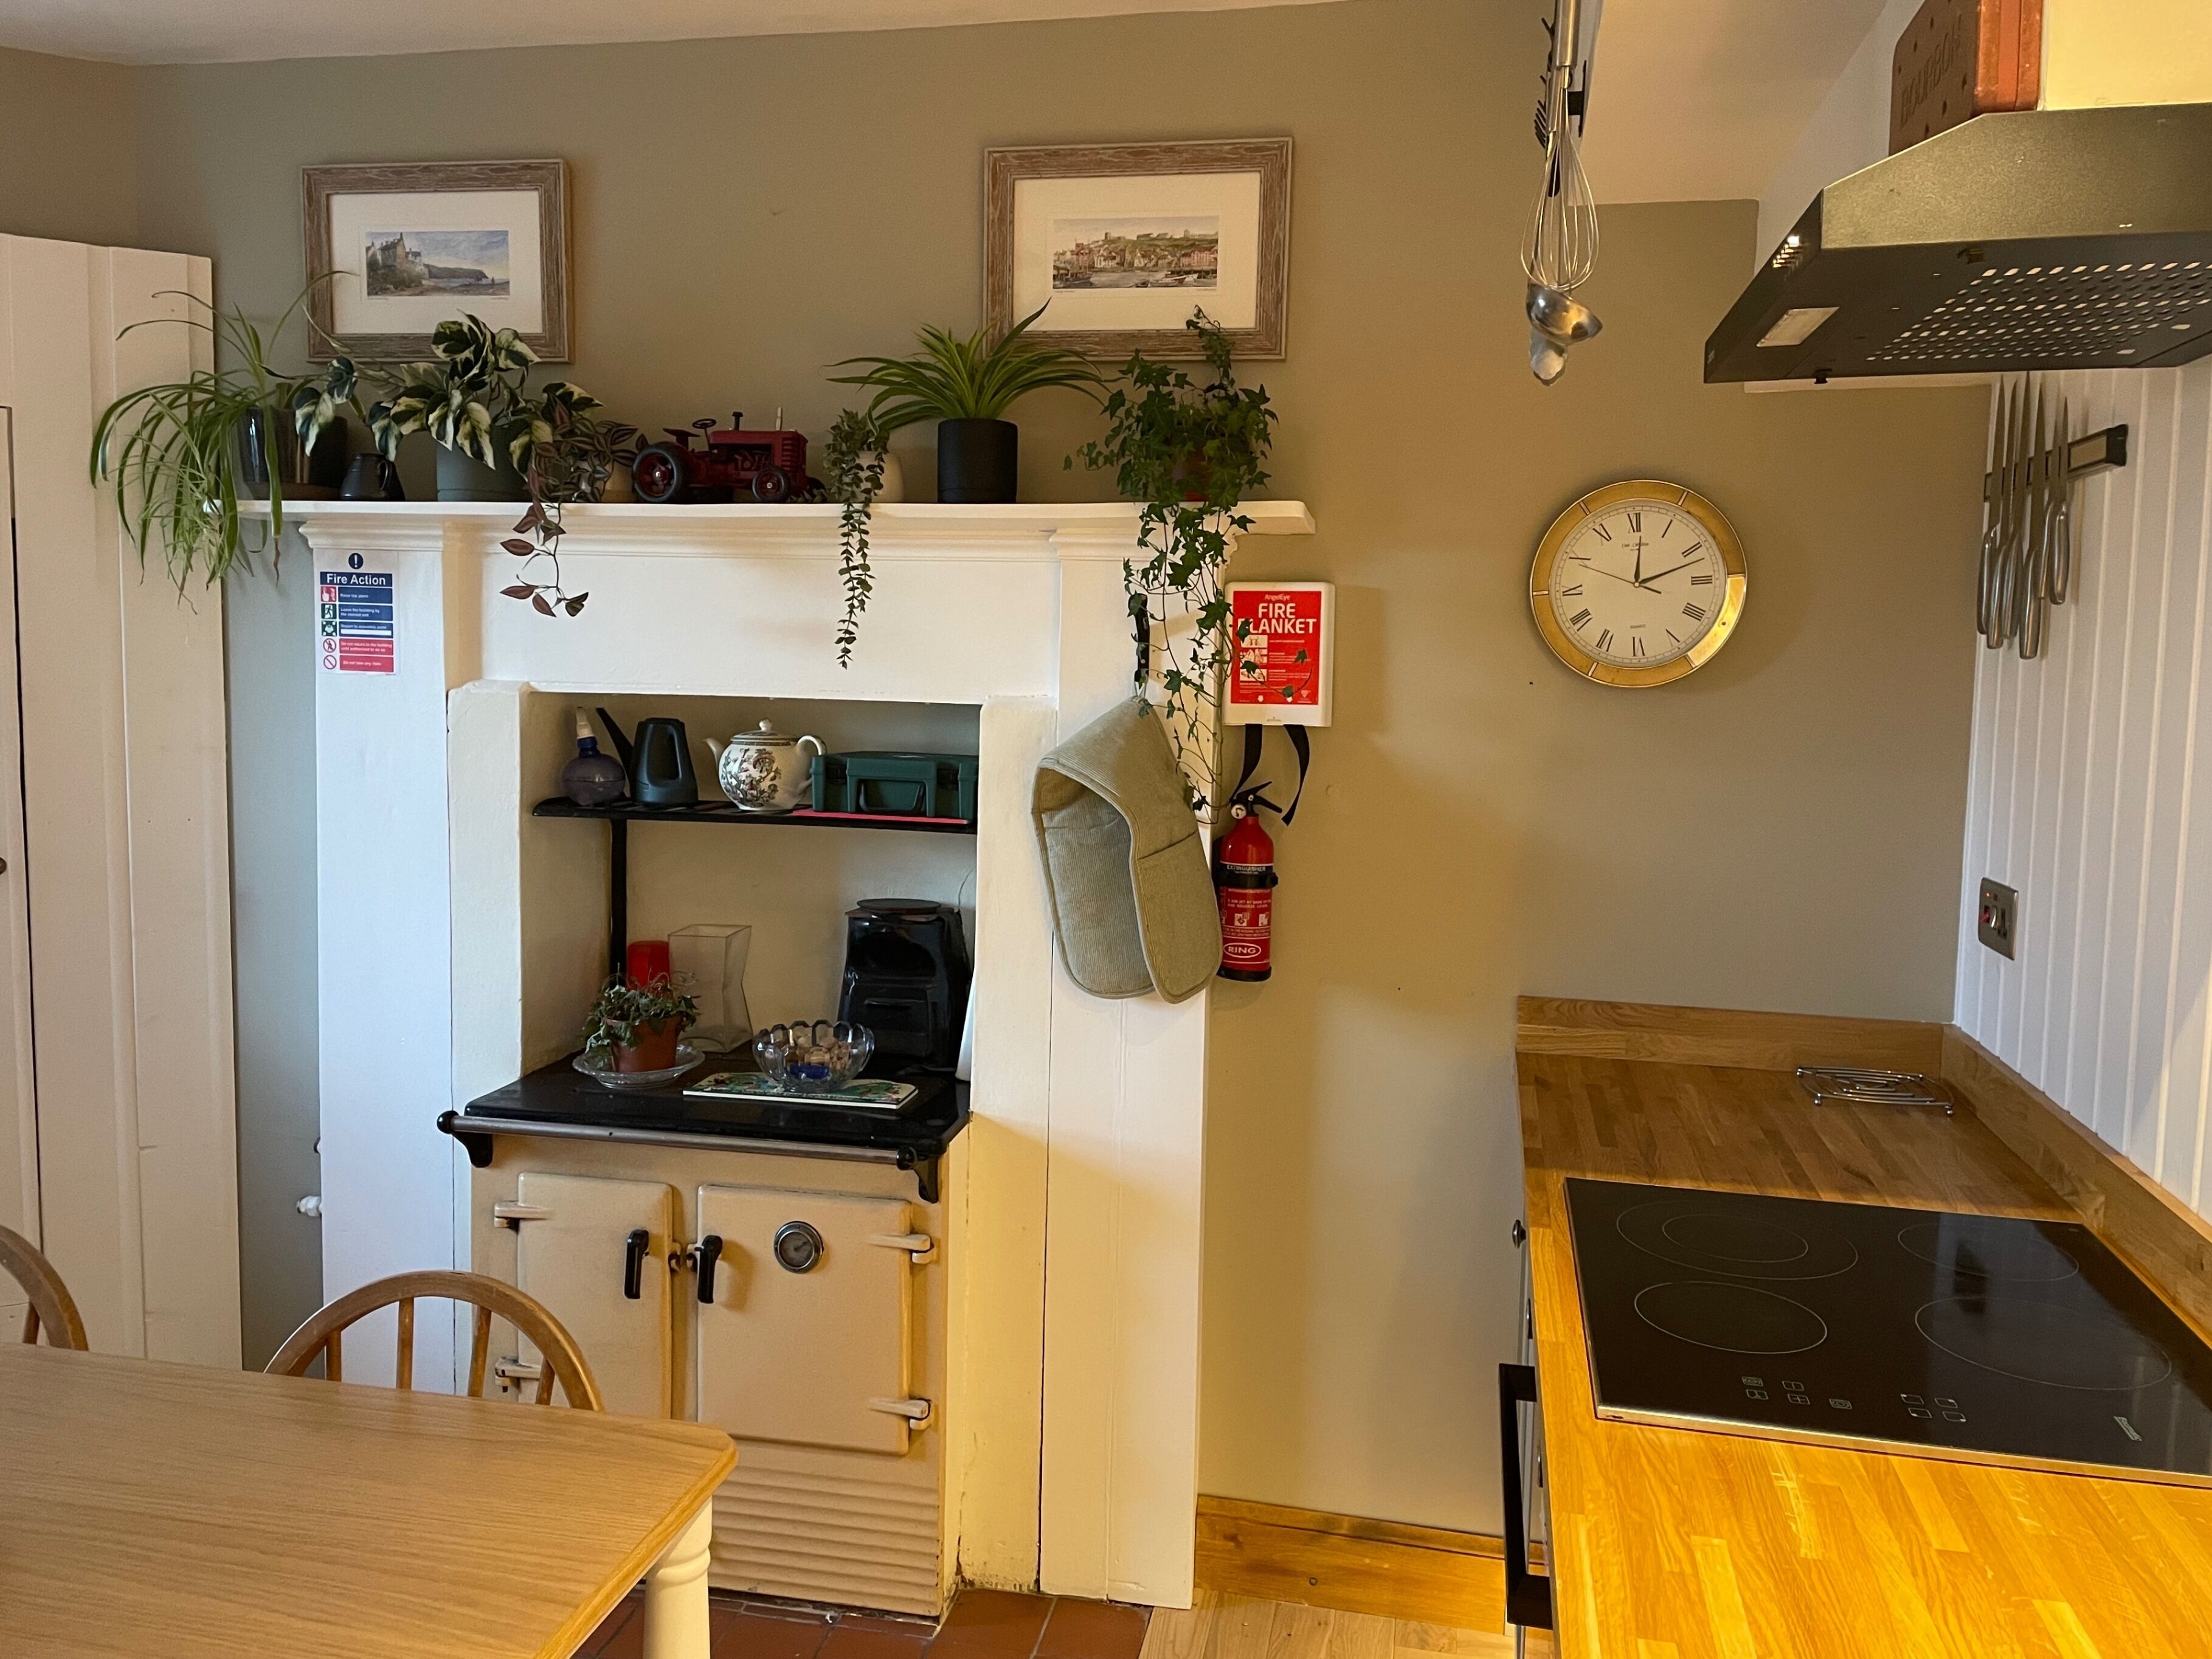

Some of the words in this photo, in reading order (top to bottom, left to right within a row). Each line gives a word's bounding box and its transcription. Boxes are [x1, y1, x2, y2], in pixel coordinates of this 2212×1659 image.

[327, 573, 348, 584] Fire
[350, 575, 386, 586] Action
[1691, 575, 1713, 585] III
[1258, 603, 1296, 618] FIRE
